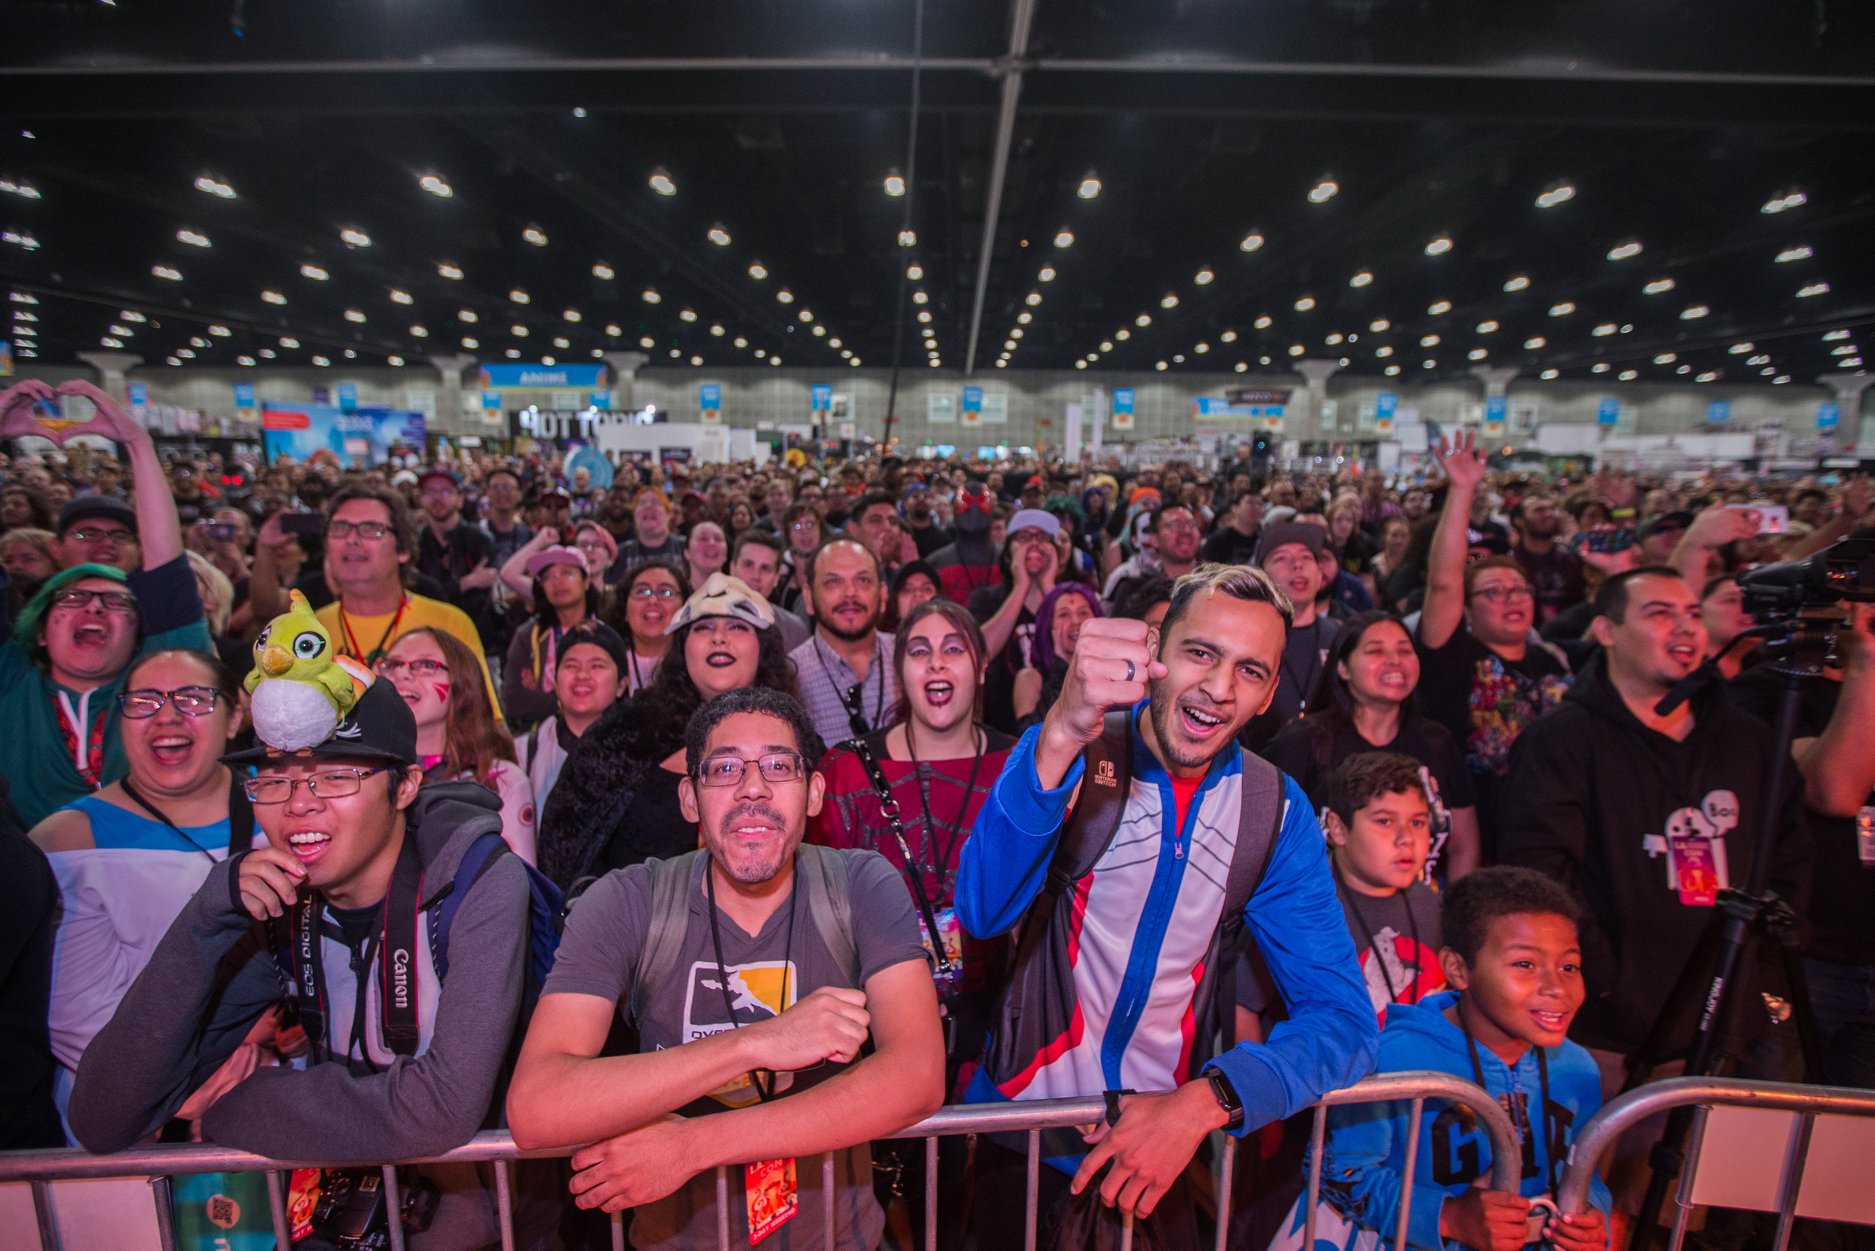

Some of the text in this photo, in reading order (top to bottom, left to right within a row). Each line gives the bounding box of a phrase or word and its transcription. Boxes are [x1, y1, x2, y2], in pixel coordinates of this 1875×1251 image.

[519, 370, 568, 386] ANIME
[519, 410, 573, 439] HOT
[301, 894, 315, 997] EOS DIGITAL
[394, 948, 410, 1009] Canon
